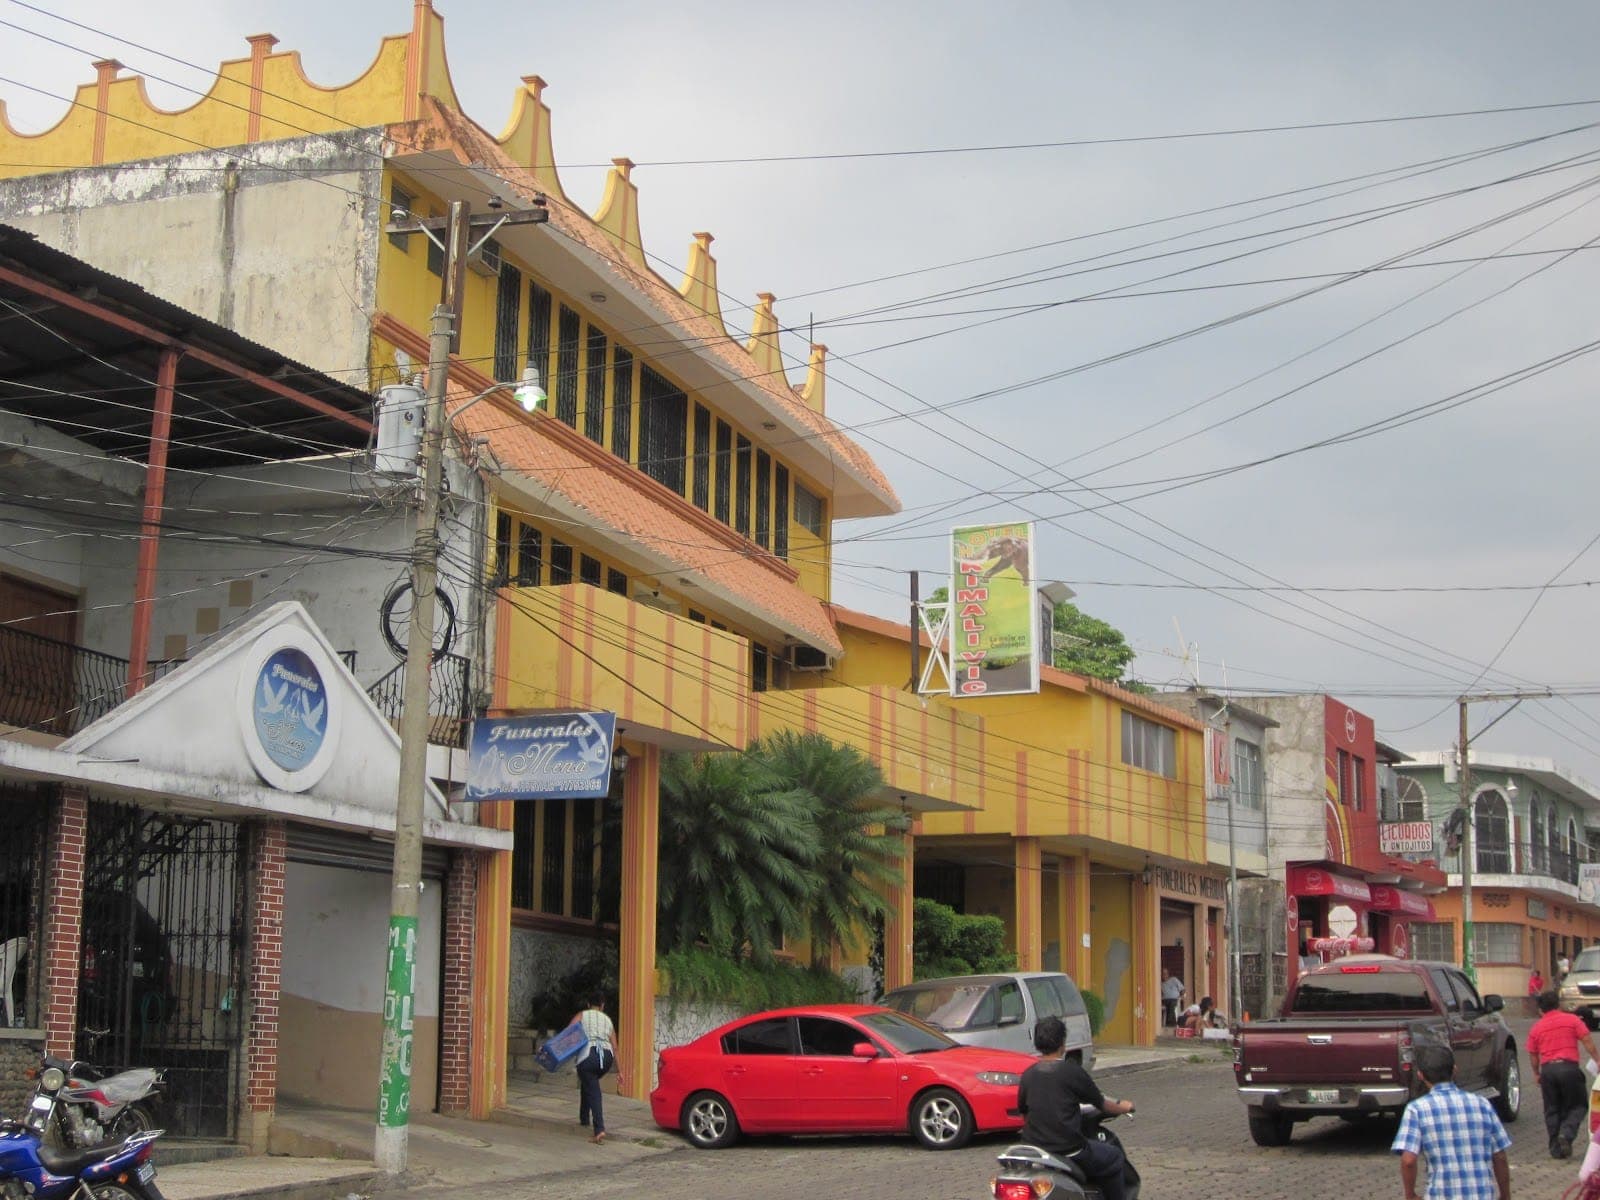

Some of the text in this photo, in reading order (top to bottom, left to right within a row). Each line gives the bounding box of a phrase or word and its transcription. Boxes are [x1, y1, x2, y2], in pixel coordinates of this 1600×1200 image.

[272, 663, 319, 693] Funerales
[487, 719, 593, 743] Funerales
[1380, 822, 1431, 841] LICUADOS
[1382, 843, 1388, 851] Y
